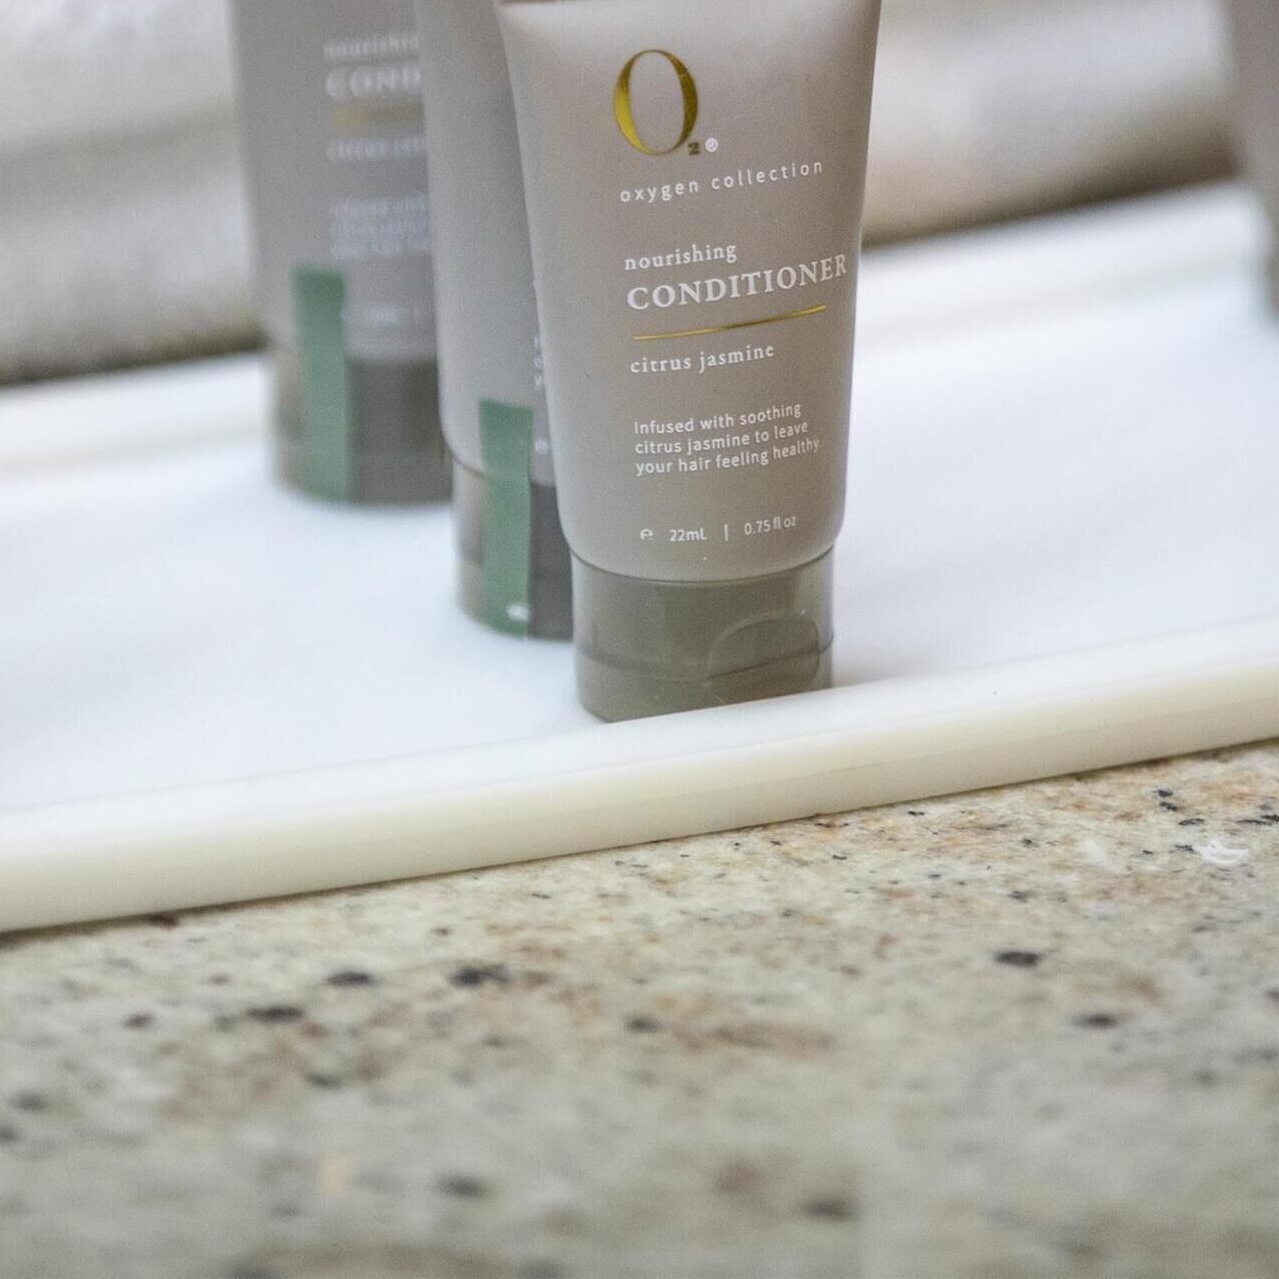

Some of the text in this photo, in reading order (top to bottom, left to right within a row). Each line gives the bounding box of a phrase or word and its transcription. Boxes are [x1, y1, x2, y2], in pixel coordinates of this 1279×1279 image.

[620, 161, 823, 203] oxygen collection
[624, 244, 738, 270] nourishing
[627, 254, 847, 310] CONDITIONER
[630, 345, 776, 374] citrus jasmine
[634, 404, 802, 434] Infused with soothing
[635, 422, 809, 455] citrus jasmine to leave
[636, 438, 820, 476] your hair feeling healthy
[670, 527, 707, 542] 22mL
[744, 519, 771, 535] 0.75
